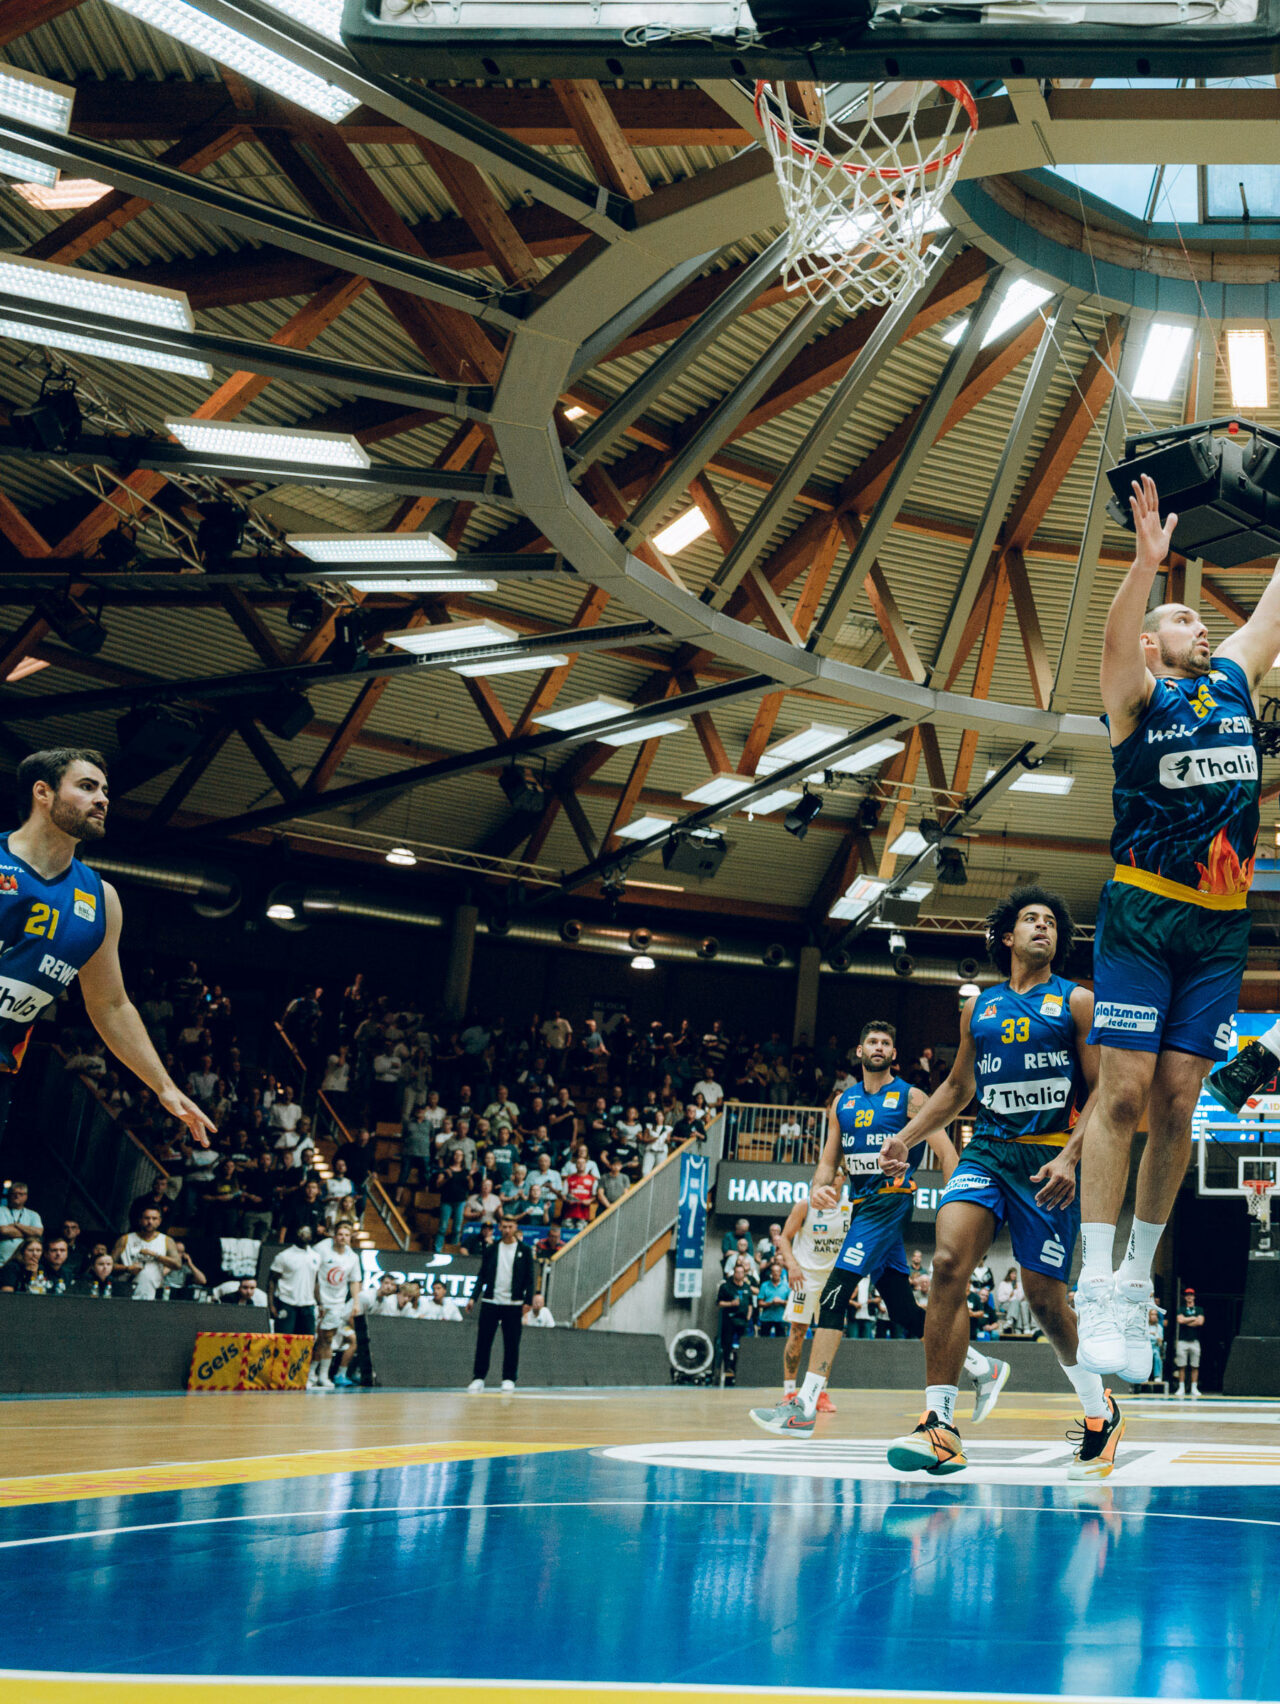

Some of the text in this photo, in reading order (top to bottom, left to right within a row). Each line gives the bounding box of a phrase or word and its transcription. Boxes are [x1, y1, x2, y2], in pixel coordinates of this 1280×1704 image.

[24, 902, 60, 940] 21
[1001, 1017, 1031, 1044] 33
[1024, 1050, 1070, 1070] REWE
[1000, 1086, 1065, 1109] Thalia
[854, 1109, 875, 1128] 29
[852, 1158, 880, 1171] Thal
[728, 1179, 809, 1203] HAKRO
[197, 1342, 239, 1380] Geis
